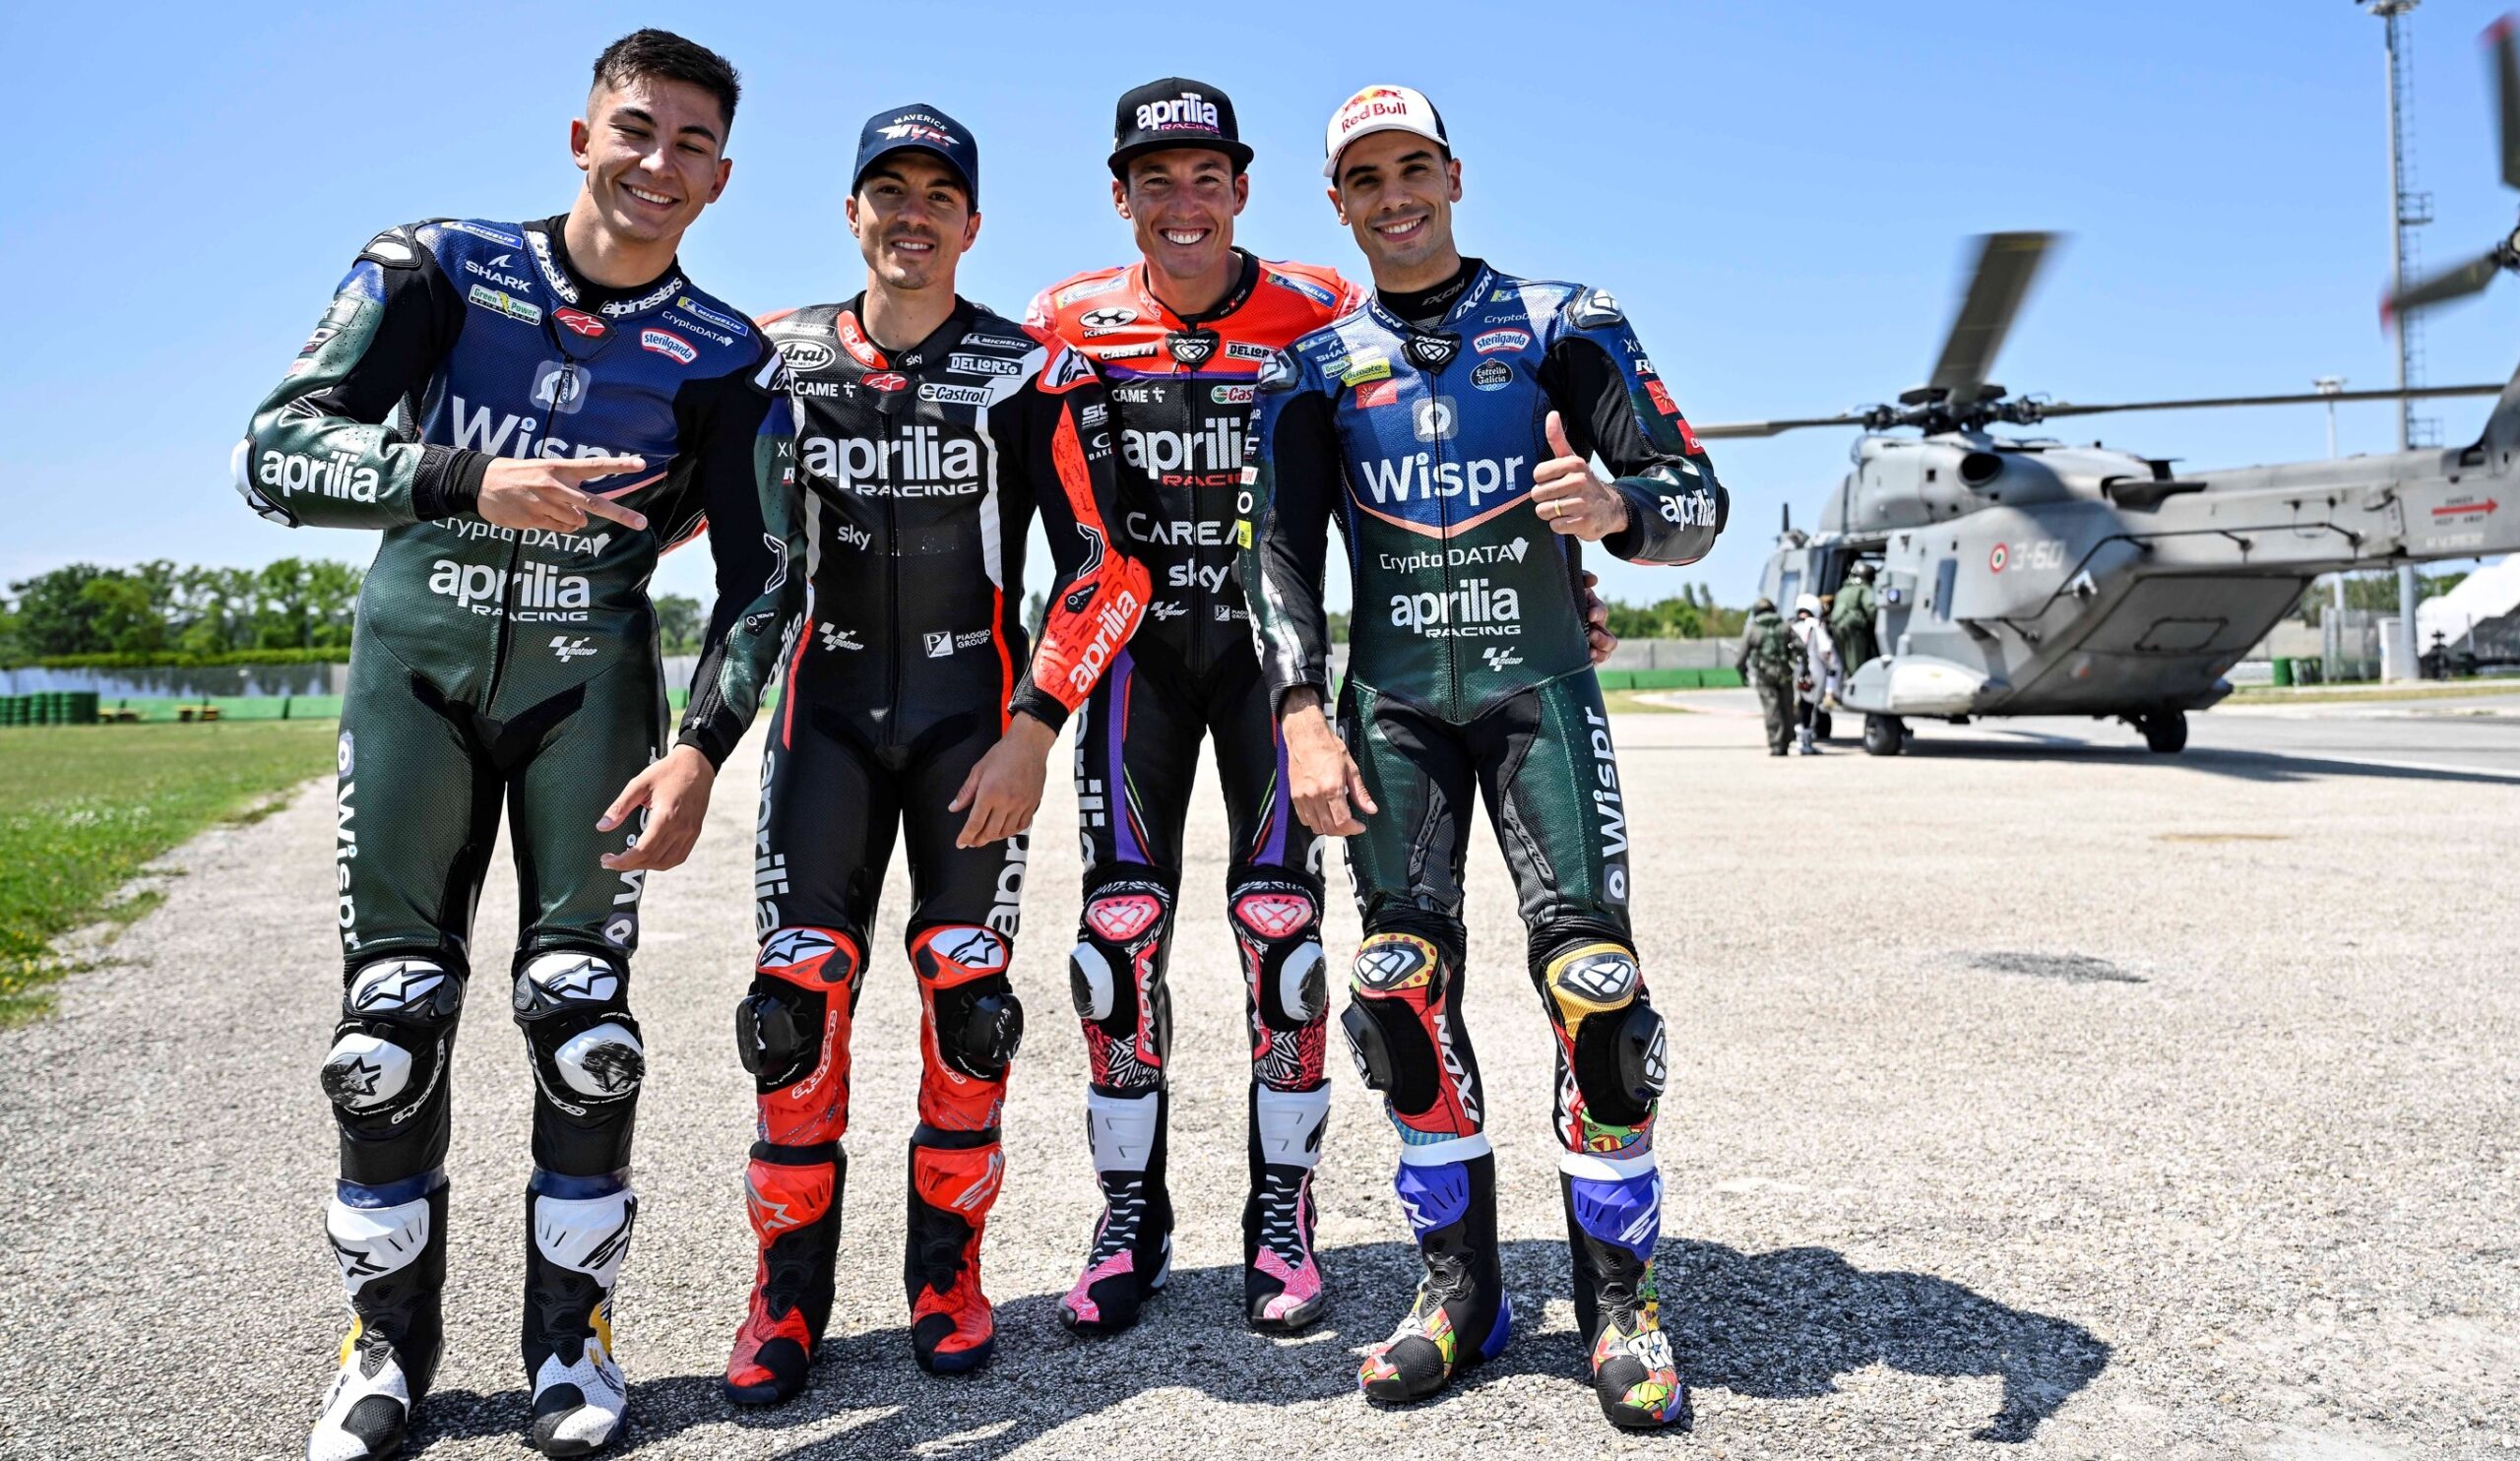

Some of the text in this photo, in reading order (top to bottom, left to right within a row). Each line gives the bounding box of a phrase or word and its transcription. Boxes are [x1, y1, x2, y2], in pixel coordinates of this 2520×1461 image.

[894, 114, 948, 131] MAVERICK
[1136, 92, 1219, 131] aprilia
[1341, 102, 1408, 133] Red Bull
[1161, 122, 1221, 134] RACING
[465, 260, 533, 293] SHARK
[474, 287, 497, 303] Green
[512, 301, 537, 317] Power
[601, 277, 683, 319] alpinestars
[1421, 278, 1466, 306] IXON
[1455, 270, 1493, 319] IXON
[662, 311, 724, 345] CryptoDATA
[697, 309, 741, 330] MICHELIN
[644, 333, 693, 359] sterilgarda
[781, 343, 826, 361] Arai
[981, 338, 1028, 348] MICHELIN
[1229, 345, 1271, 358] DELLOR
[1477, 333, 1527, 349] sterilgarda
[906, 353, 922, 366] sky
[1477, 366, 1507, 377] Estrella
[795, 381, 838, 397] CAME
[1478, 375, 1506, 385] Galicia
[936, 386, 985, 404] Castrol
[1111, 389, 1148, 403] CAME
[802, 425, 978, 489] aprilia
[1089, 448, 1113, 461] OAKL
[1120, 417, 1242, 479] aprili
[261, 449, 380, 503] aprilia
[1162, 475, 1242, 486] RACI
[1361, 452, 1524, 506] Wispr
[855, 481, 978, 498] RACING
[1659, 487, 1717, 532] aprilia
[838, 525, 871, 551] sky
[429, 559, 590, 608] aprilia
[1168, 558, 1228, 594] sky
[472, 605, 588, 622] RACING
[1390, 578, 1521, 634] aprilia
[956, 629, 991, 641] PIAGGIO
[957, 637, 988, 649] GROUP
[1069, 590, 1138, 693] aprilia
[1425, 624, 1522, 638] RACING
[1585, 706, 1628, 858] Wispr
[1433, 1014, 1480, 1123] IXON
